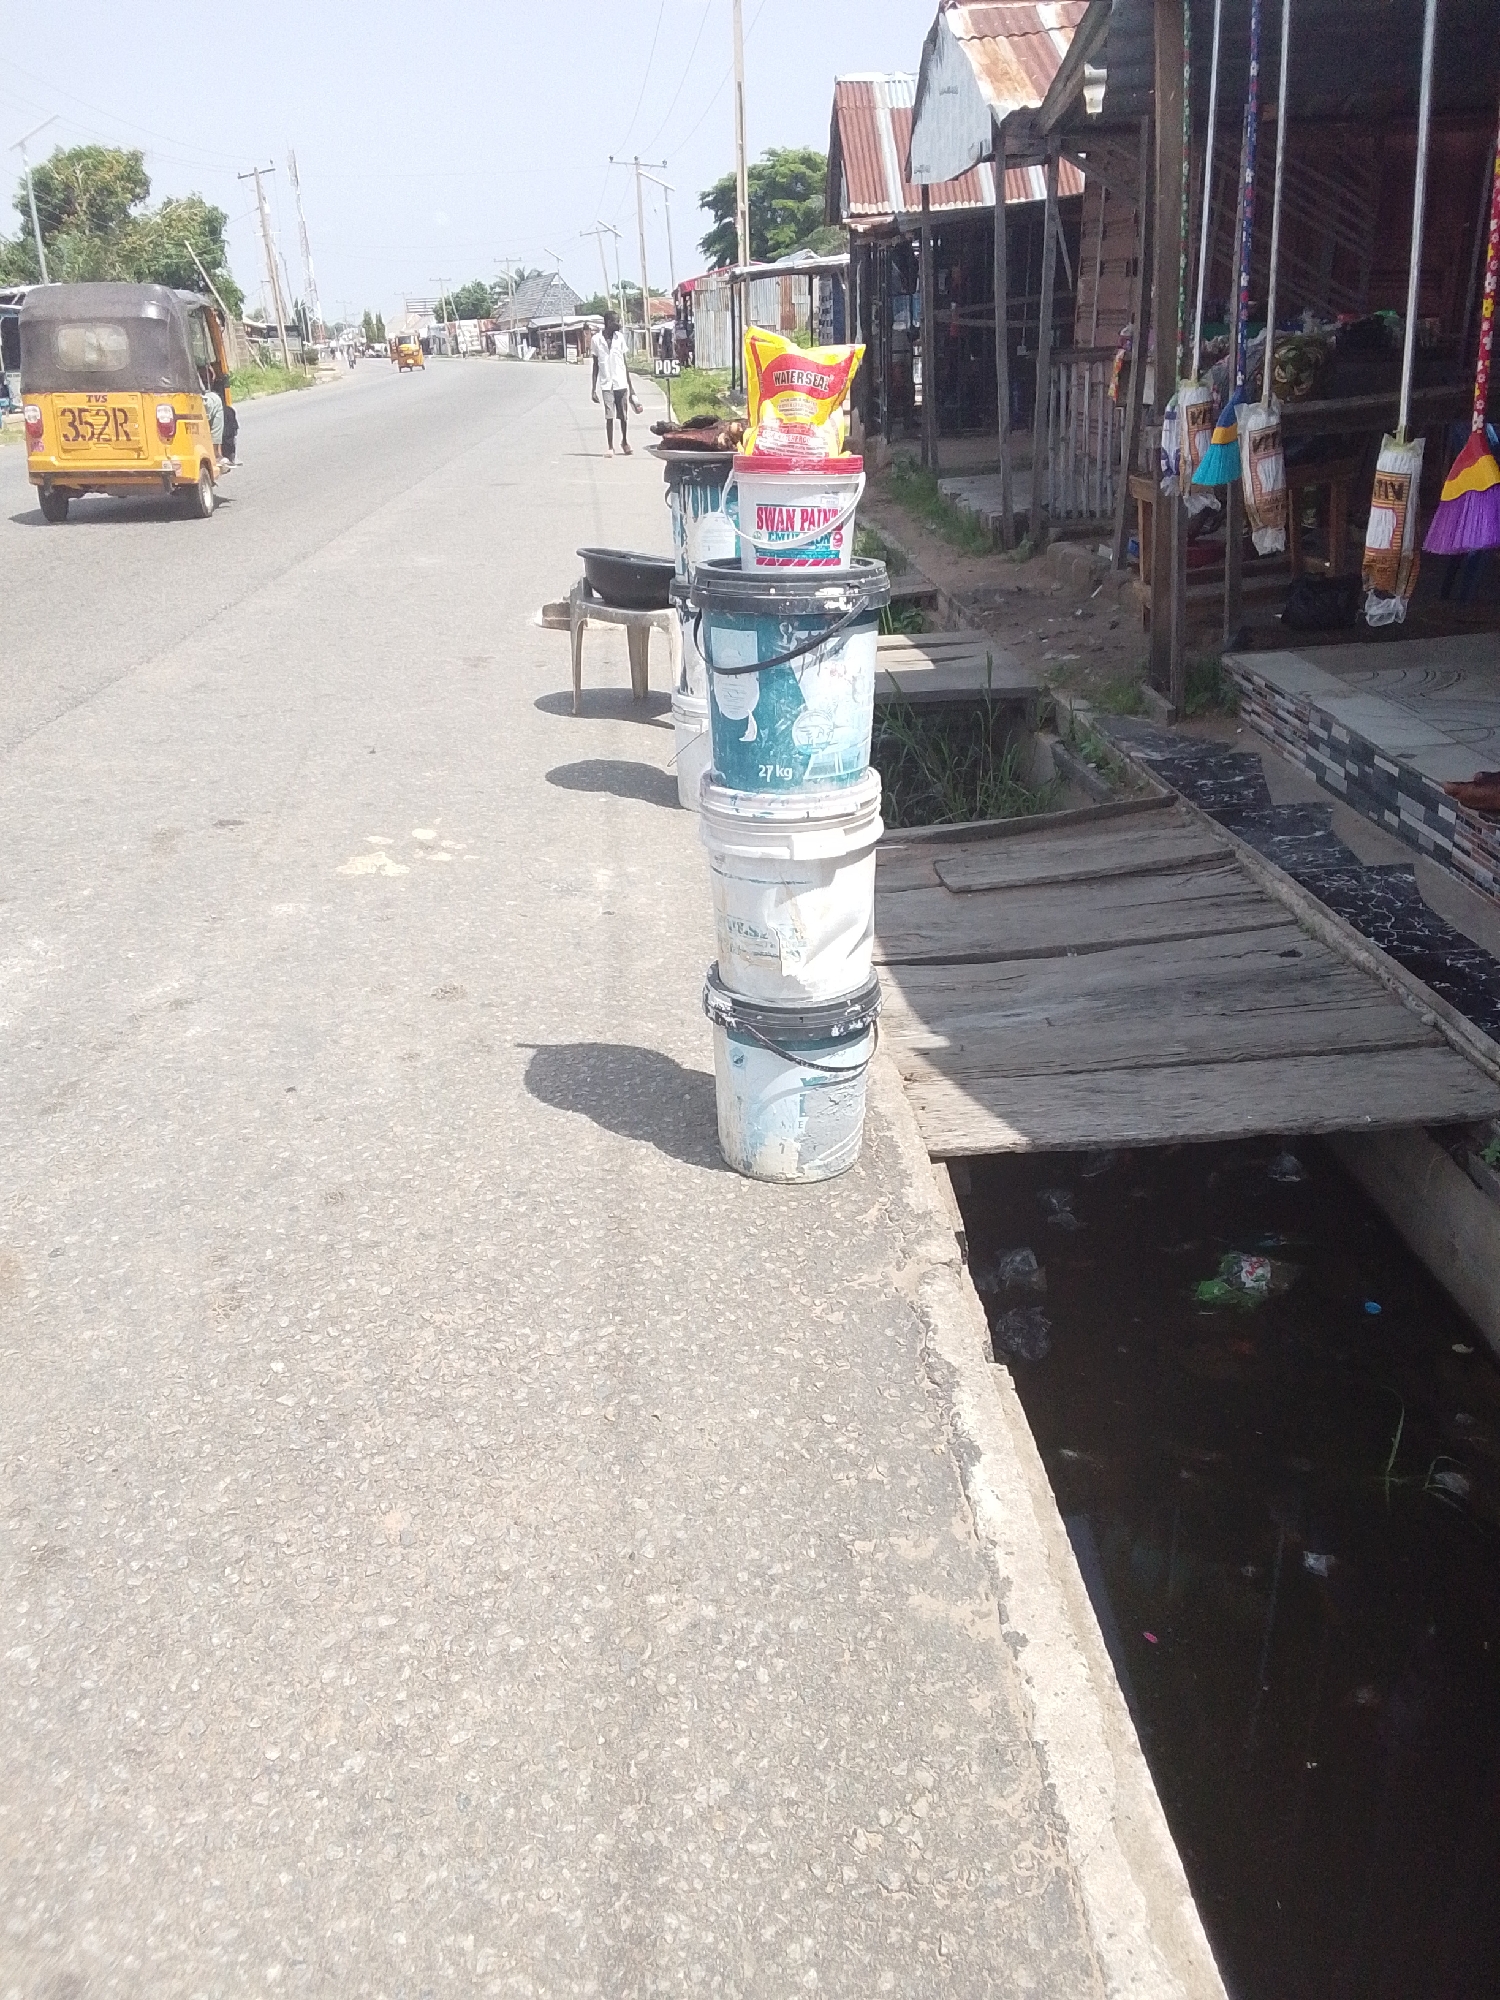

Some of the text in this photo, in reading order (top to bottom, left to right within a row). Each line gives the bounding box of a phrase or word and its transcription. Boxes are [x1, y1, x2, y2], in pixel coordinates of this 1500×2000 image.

[655, 359, 681, 375] POS
[773, 369, 830, 392] WATERSEAL
[86, 395, 108, 404] TVS
[60, 407, 133, 443] 352R
[756, 506, 796, 532] SWAN
[758, 764, 793, 783] 27 kg
